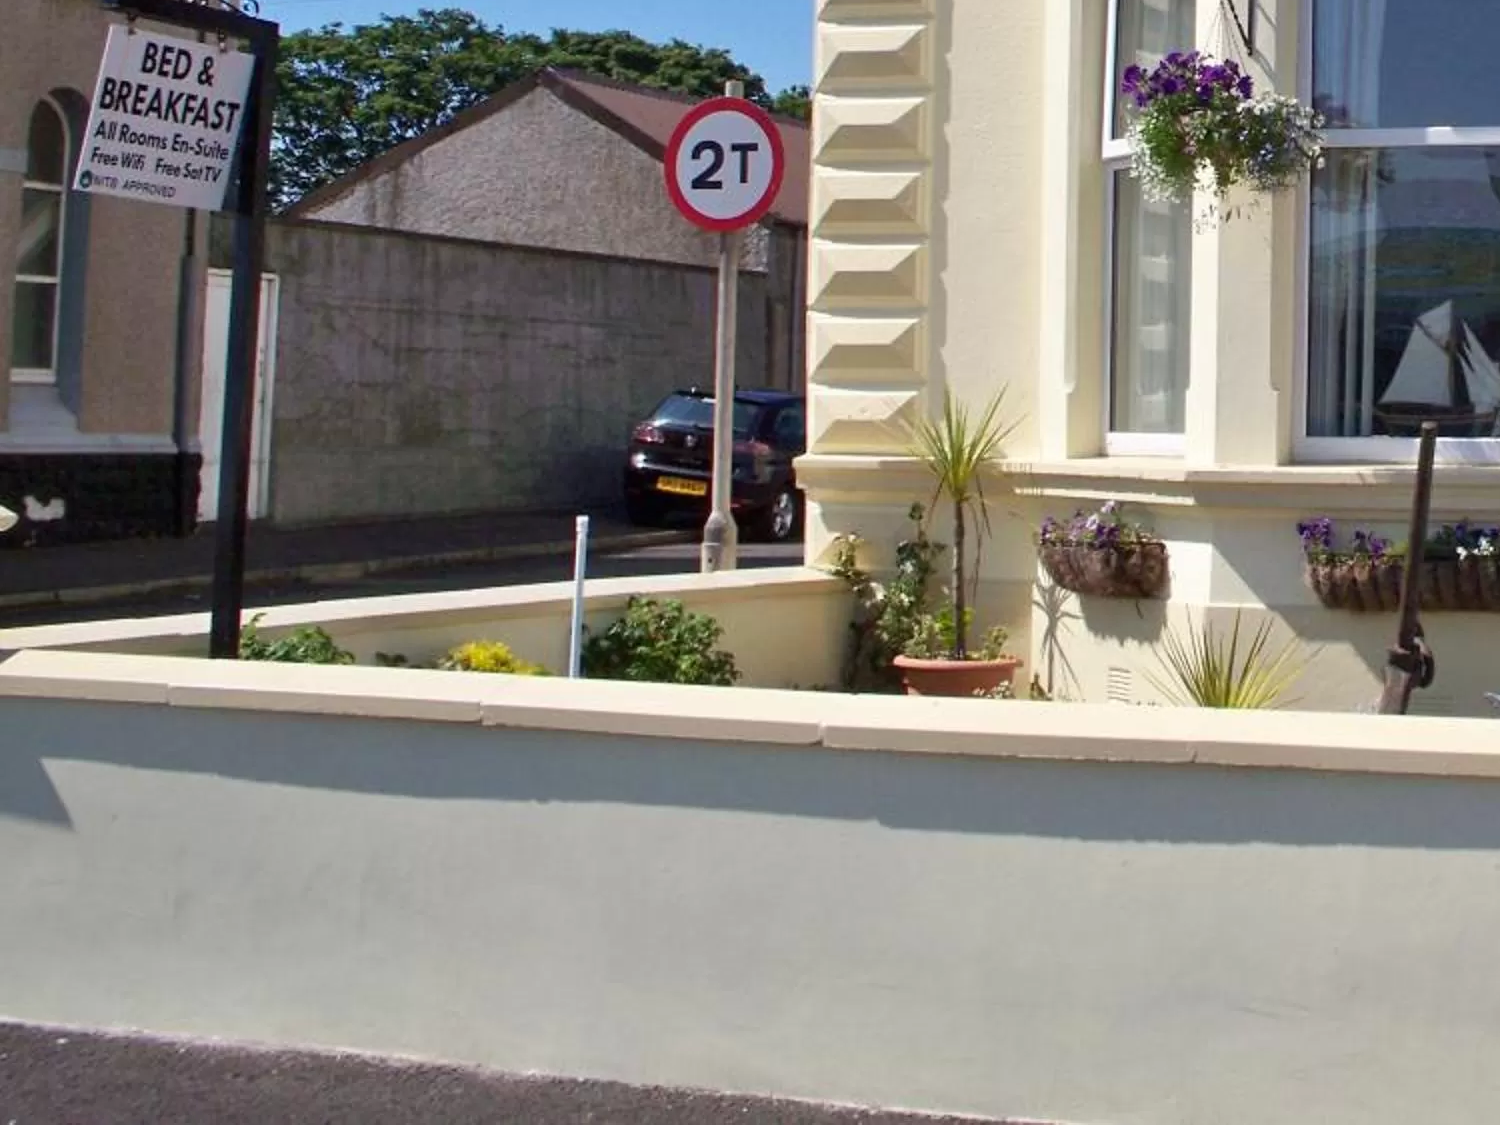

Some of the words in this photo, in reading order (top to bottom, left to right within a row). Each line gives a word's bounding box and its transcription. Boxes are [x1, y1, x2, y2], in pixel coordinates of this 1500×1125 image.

[142, 43, 193, 80] BED
[197, 56, 214, 88] &
[100, 77, 241, 133] BREAKFAST
[94, 120, 118, 140] All
[119, 124, 168, 150] Rooms
[171, 133, 230, 160] En-Suite
[91, 146, 119, 166] Free
[155, 158, 181, 177] Free
[204, 165, 223, 183] TV
[691, 140, 759, 190] 2T
